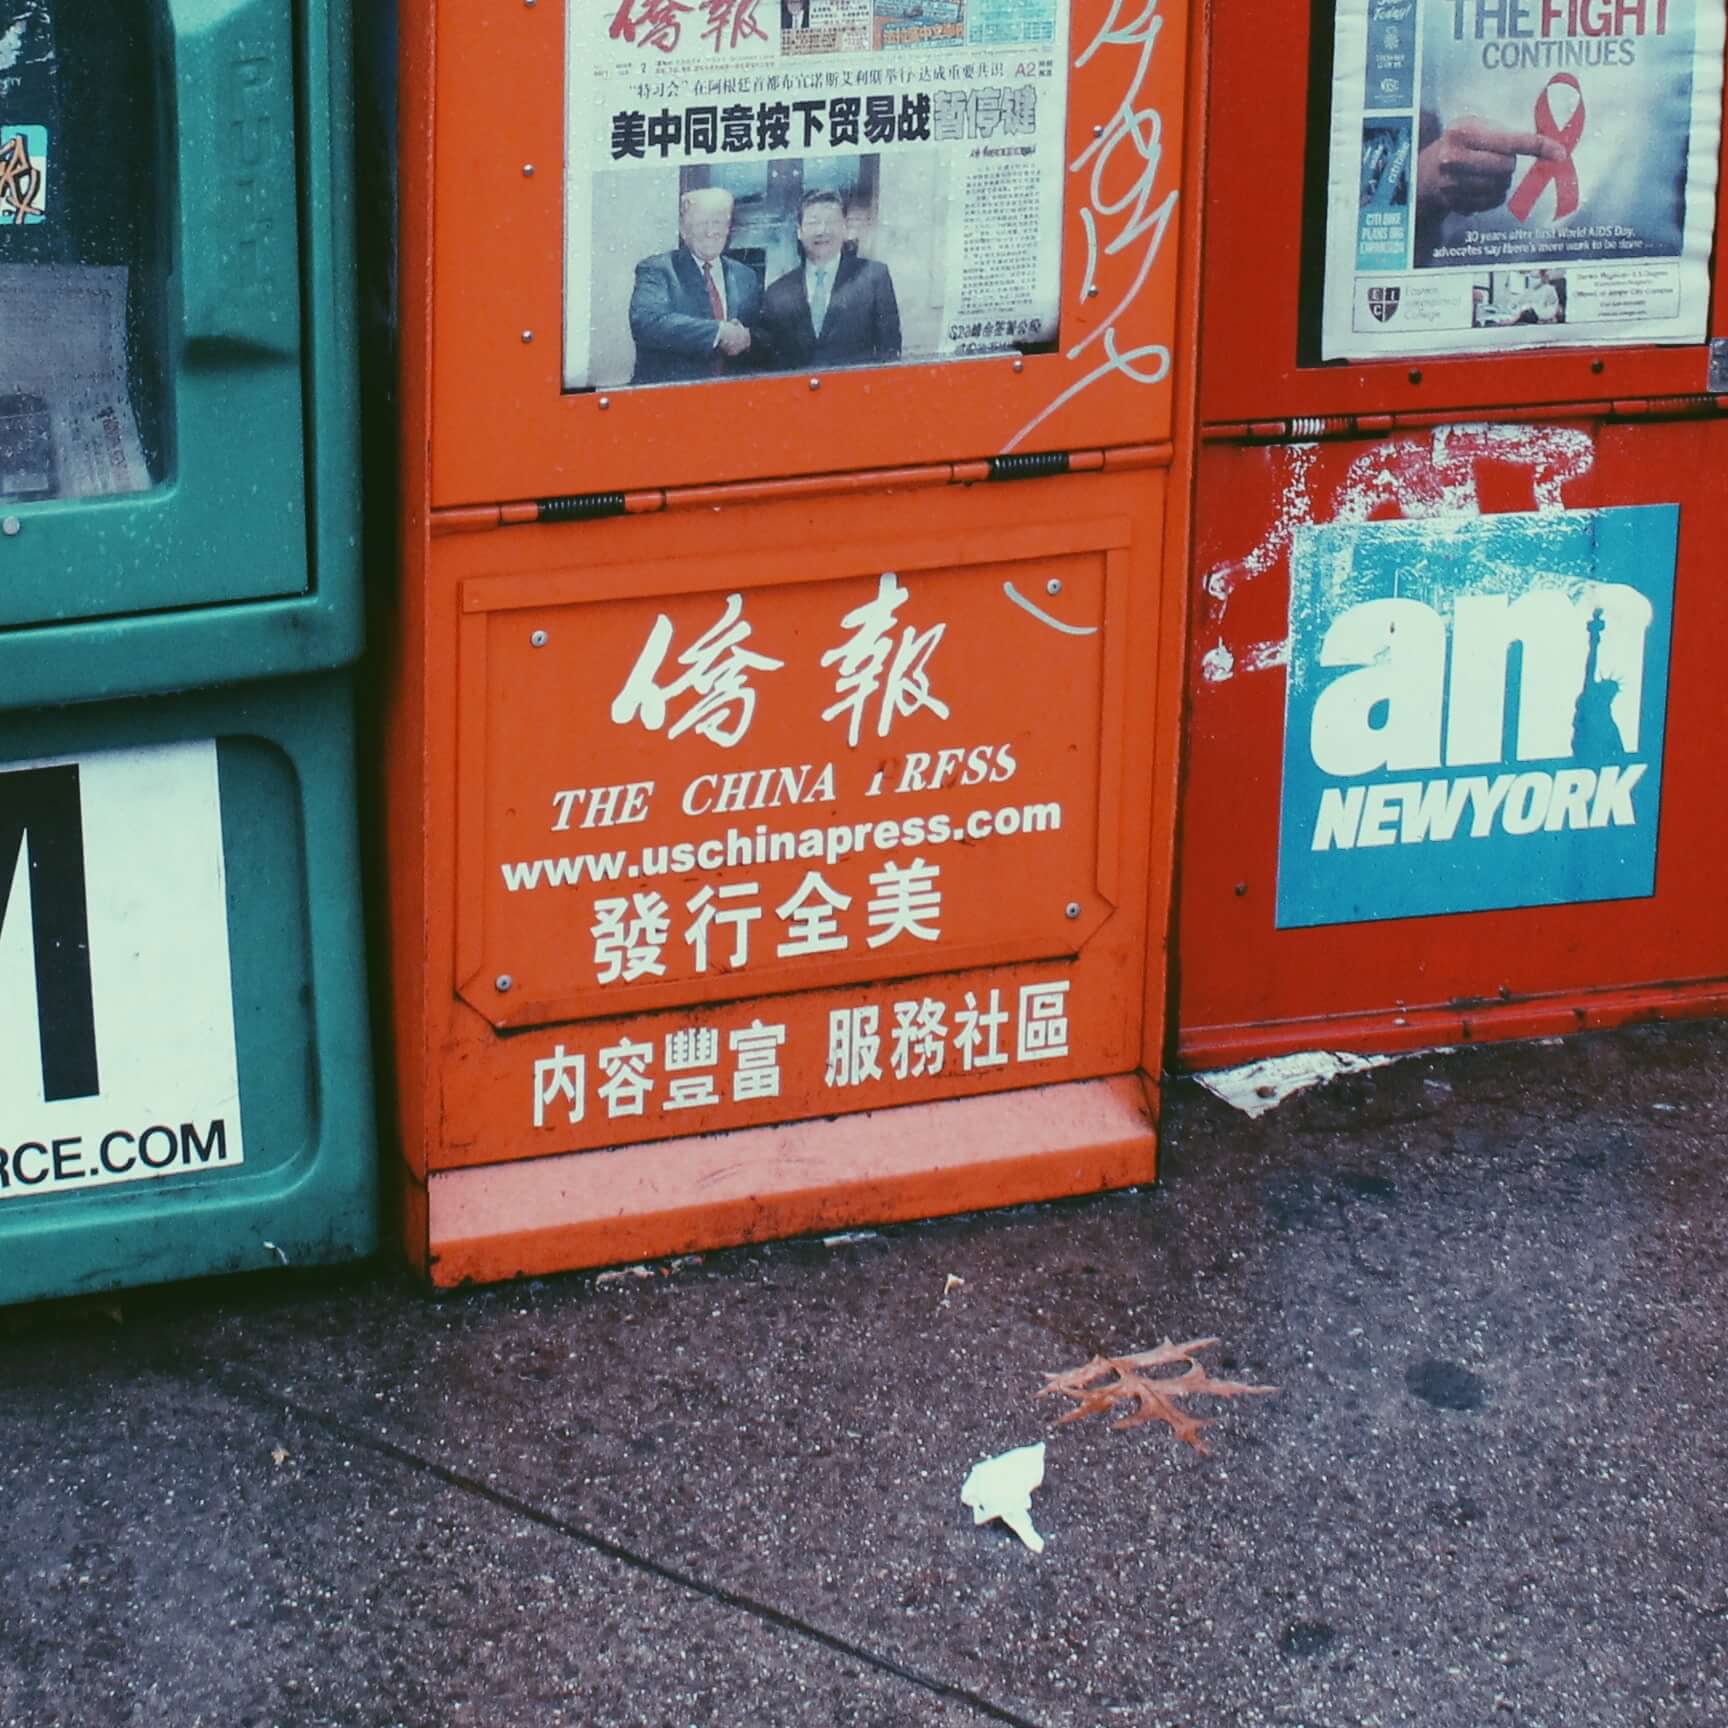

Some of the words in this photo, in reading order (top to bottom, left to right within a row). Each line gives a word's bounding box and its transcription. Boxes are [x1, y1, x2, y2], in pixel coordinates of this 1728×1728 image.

[1013, 62, 1037, 79] A2
[1480, 39, 1636, 71] CONTINUES
[1432, 244, 1483, 259] advocates
[1565, 239, 1590, 252] work
[1591, 239, 1603, 250] to
[1603, 238, 1618, 250] be
[1464, 230, 1479, 243] 30
[1479, 230, 1507, 245] years
[1558, 227, 1587, 239] World
[1587, 225, 1614, 238] AIDS
[610, 571, 951, 749] 僑報
[1309, 581, 1654, 778] am
[550, 780, 656, 834] THE
[680, 761, 838, 818] CHINA
[1310, 763, 1649, 853] NEWYORK
[501, 801, 1063, 893] www.uschinapress.com
[589, 857, 943, 985] 發行全美
[825, 979, 1072, 1089] 服務社區
